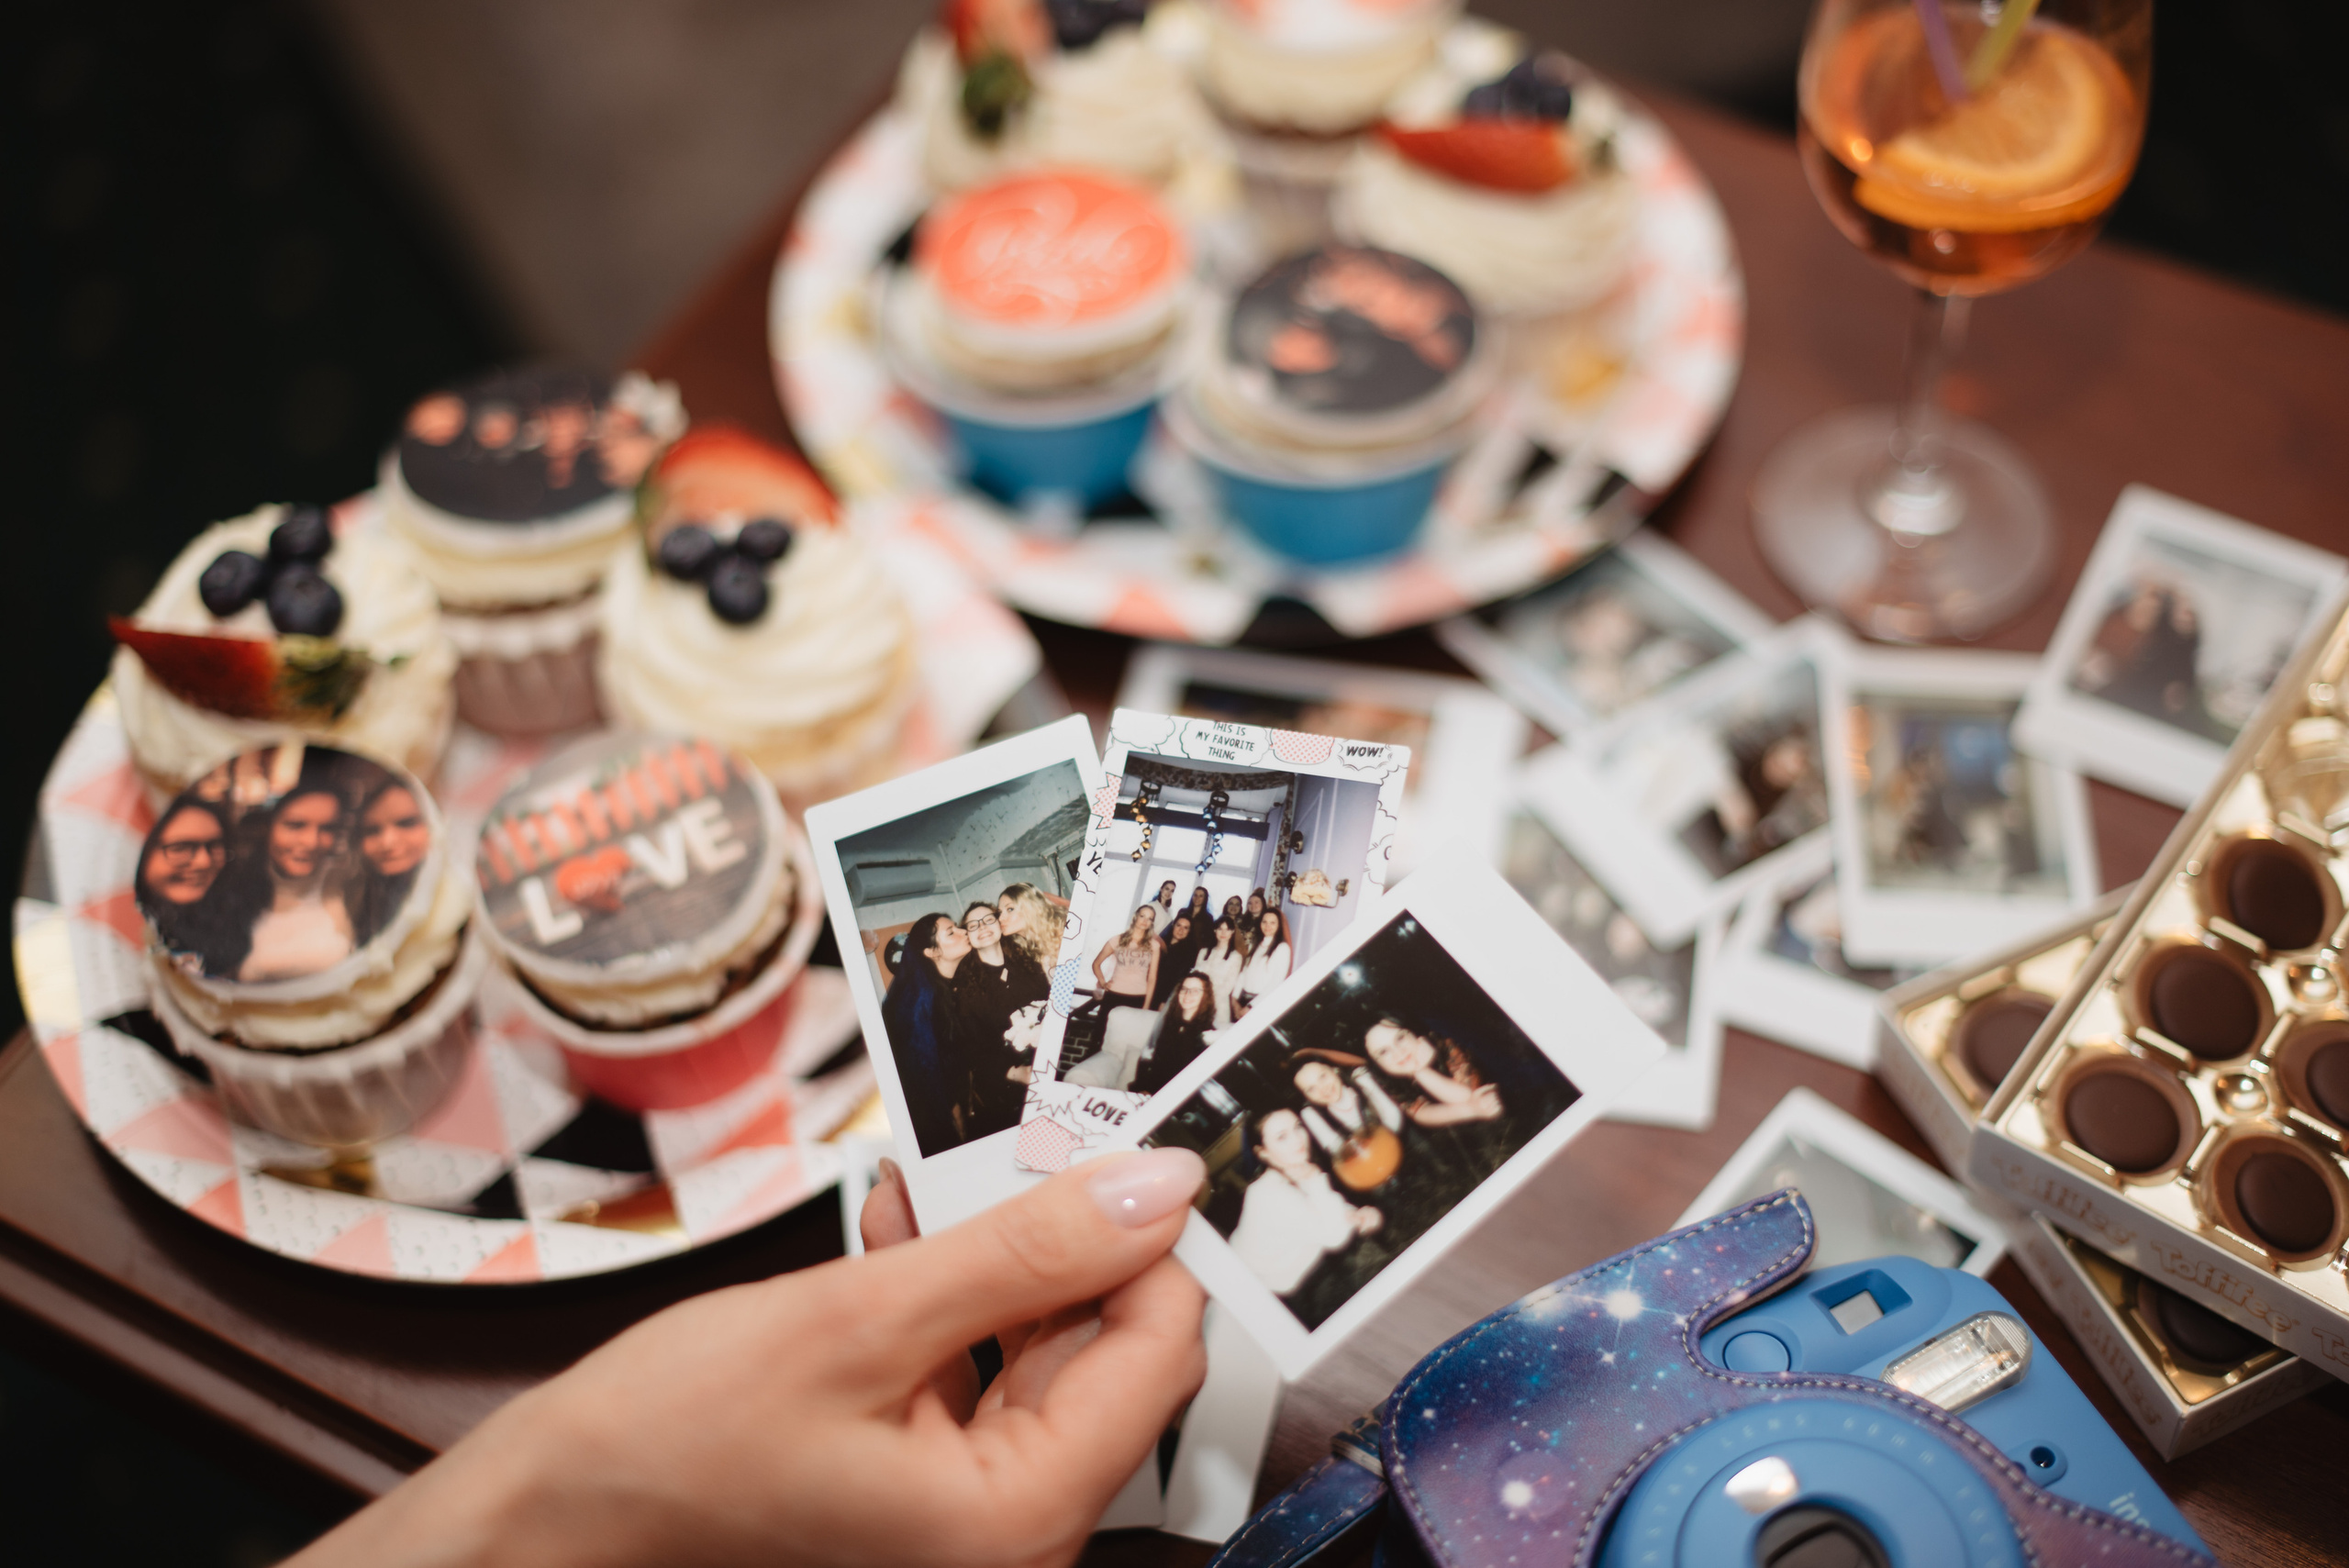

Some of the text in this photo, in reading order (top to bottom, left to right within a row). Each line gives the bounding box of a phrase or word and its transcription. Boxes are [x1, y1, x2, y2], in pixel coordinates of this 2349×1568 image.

[1212, 720, 1247, 737] THIS IS
[1195, 730, 1255, 752] MY FAVORITE
[1346, 745, 1385, 759] WOW!
[1208, 746, 1236, 761] THING
[518, 796, 748, 947] LVE
[1082, 1096, 1130, 1127] LOVE
[2150, 1240, 2293, 1333] Toffifee
